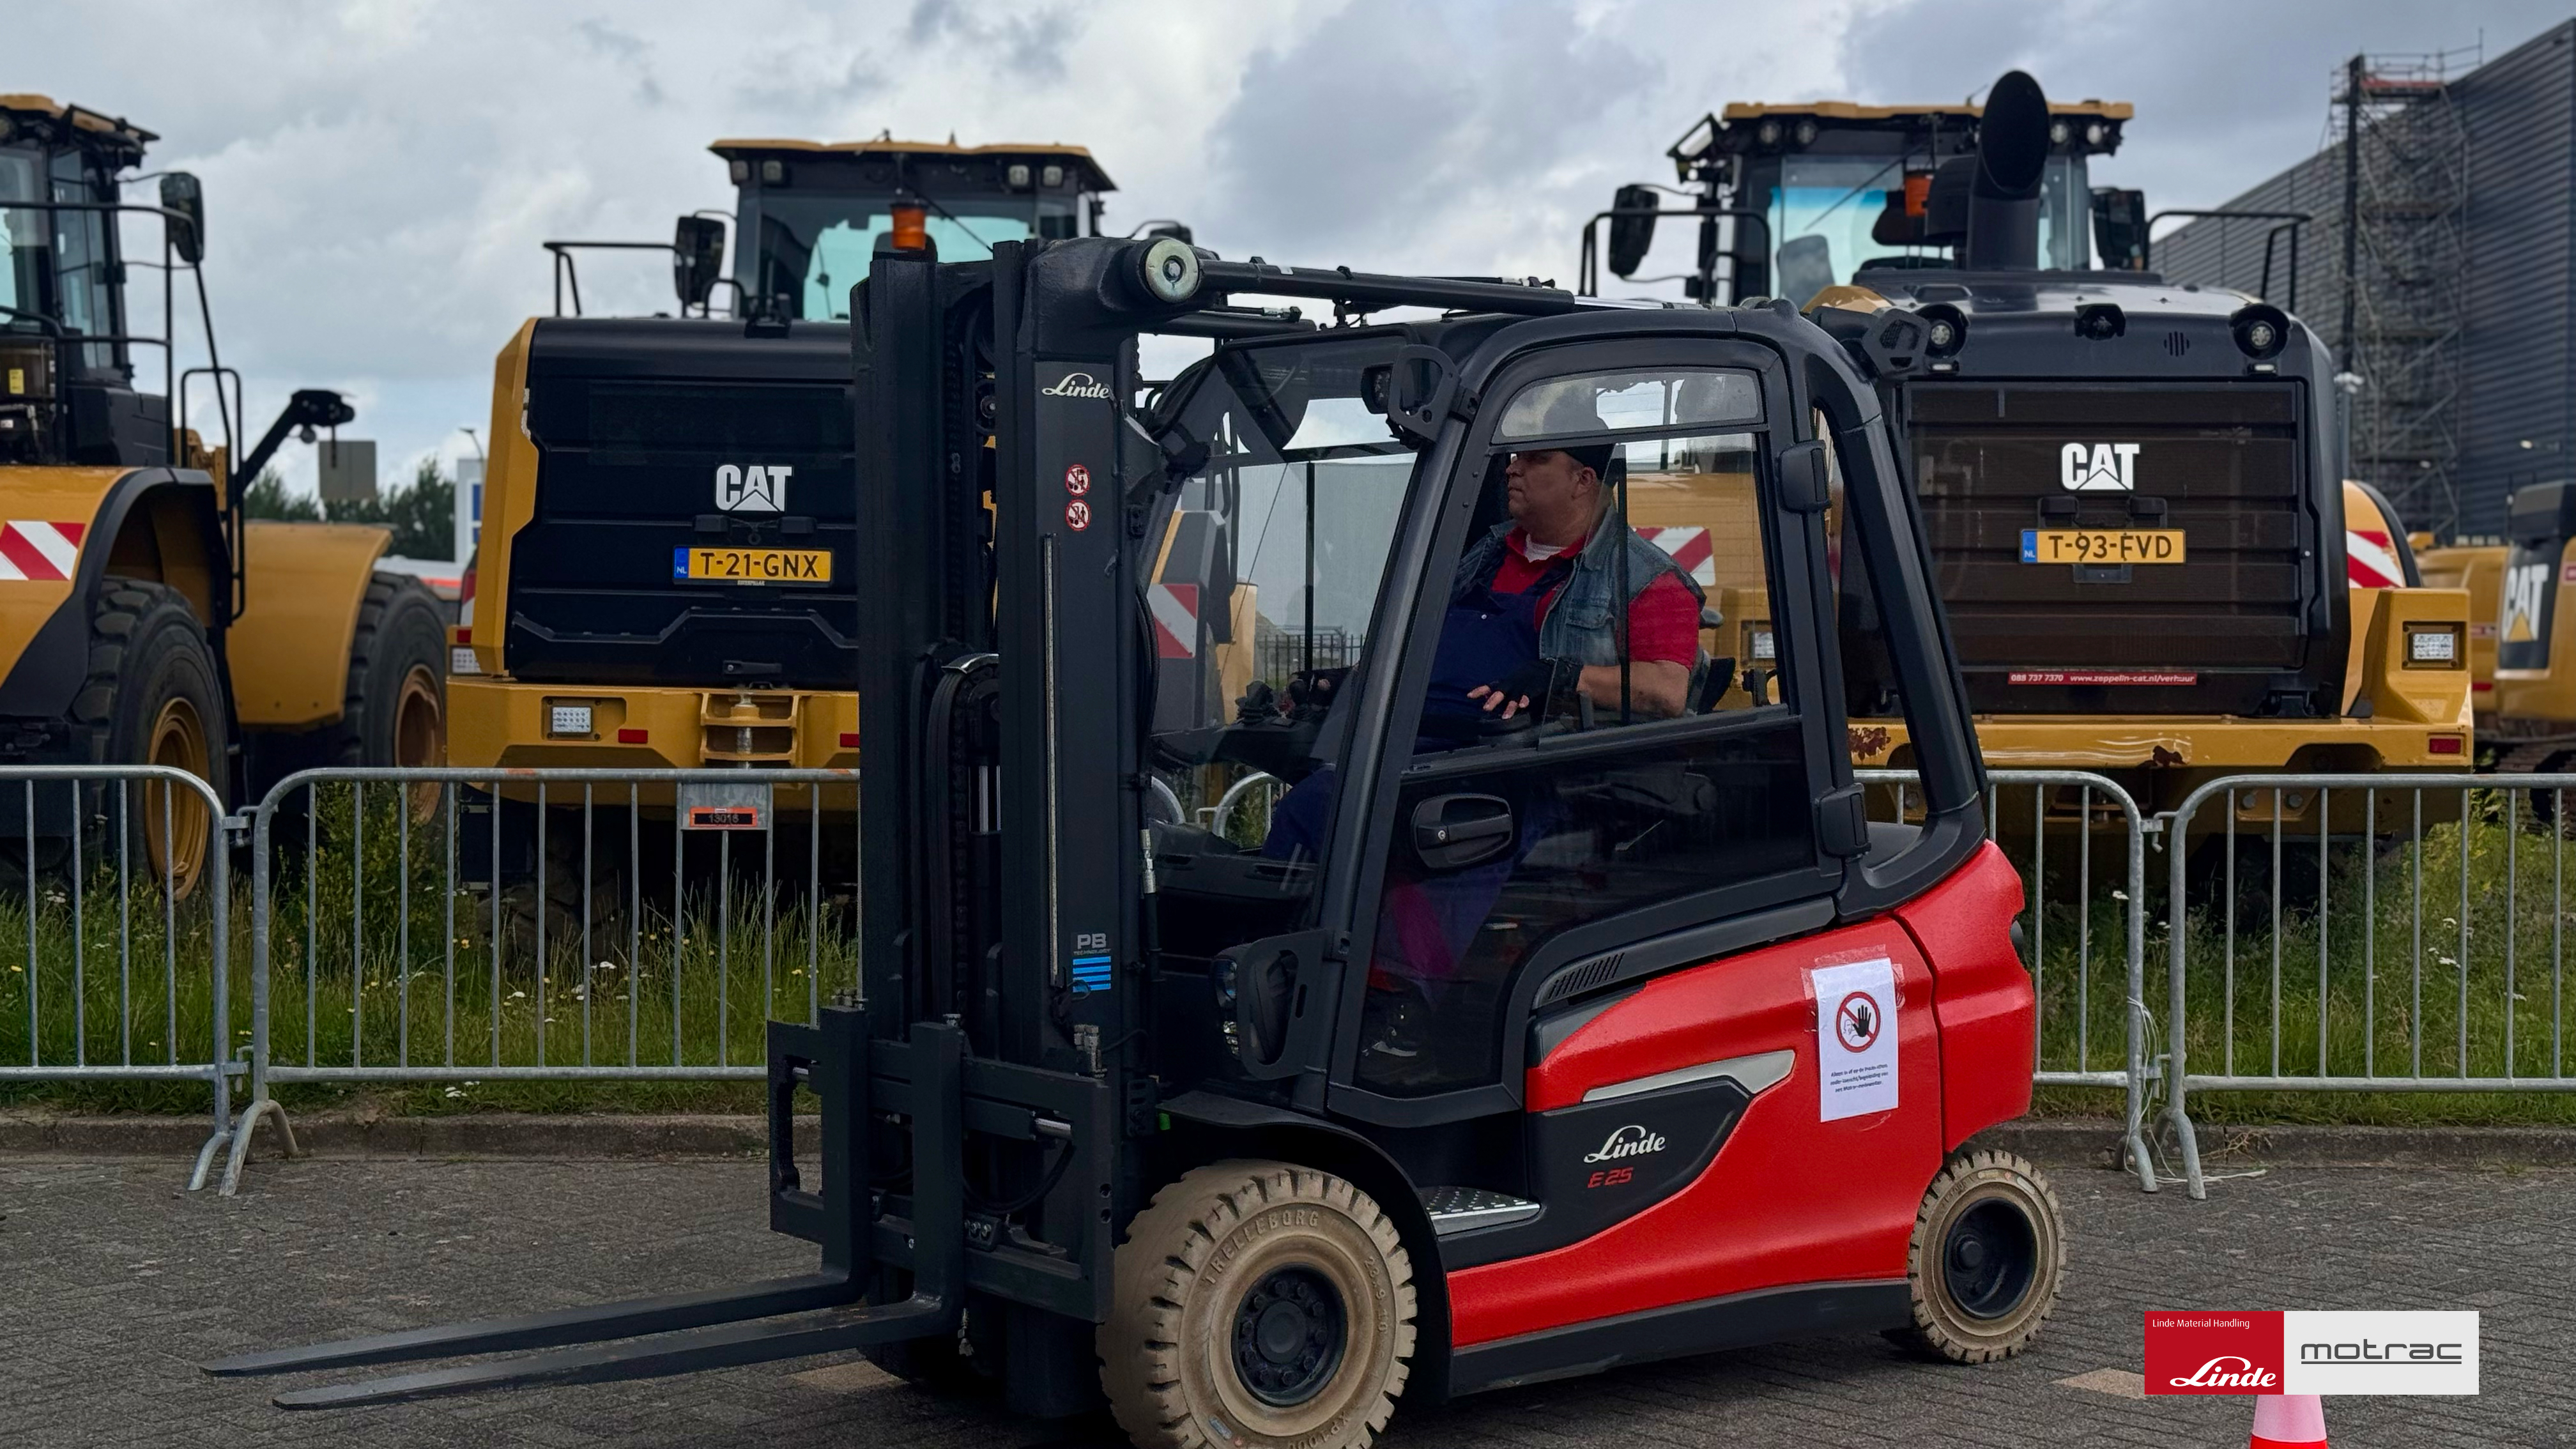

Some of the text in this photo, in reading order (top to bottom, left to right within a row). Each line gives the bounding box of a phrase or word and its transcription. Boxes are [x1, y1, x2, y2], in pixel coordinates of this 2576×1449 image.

[1041, 372, 1110, 399] Linde
[2061, 443, 2140, 491] CAT
[716, 464, 792, 512] CAT
[2048, 535, 2172, 560] T-93-FVD
[700, 552, 818, 578] T-21-GNX
[2501, 563, 2550, 643] CAT
[1077, 933, 1107, 950] PB
[1583, 1125, 1666, 1163] Linde
